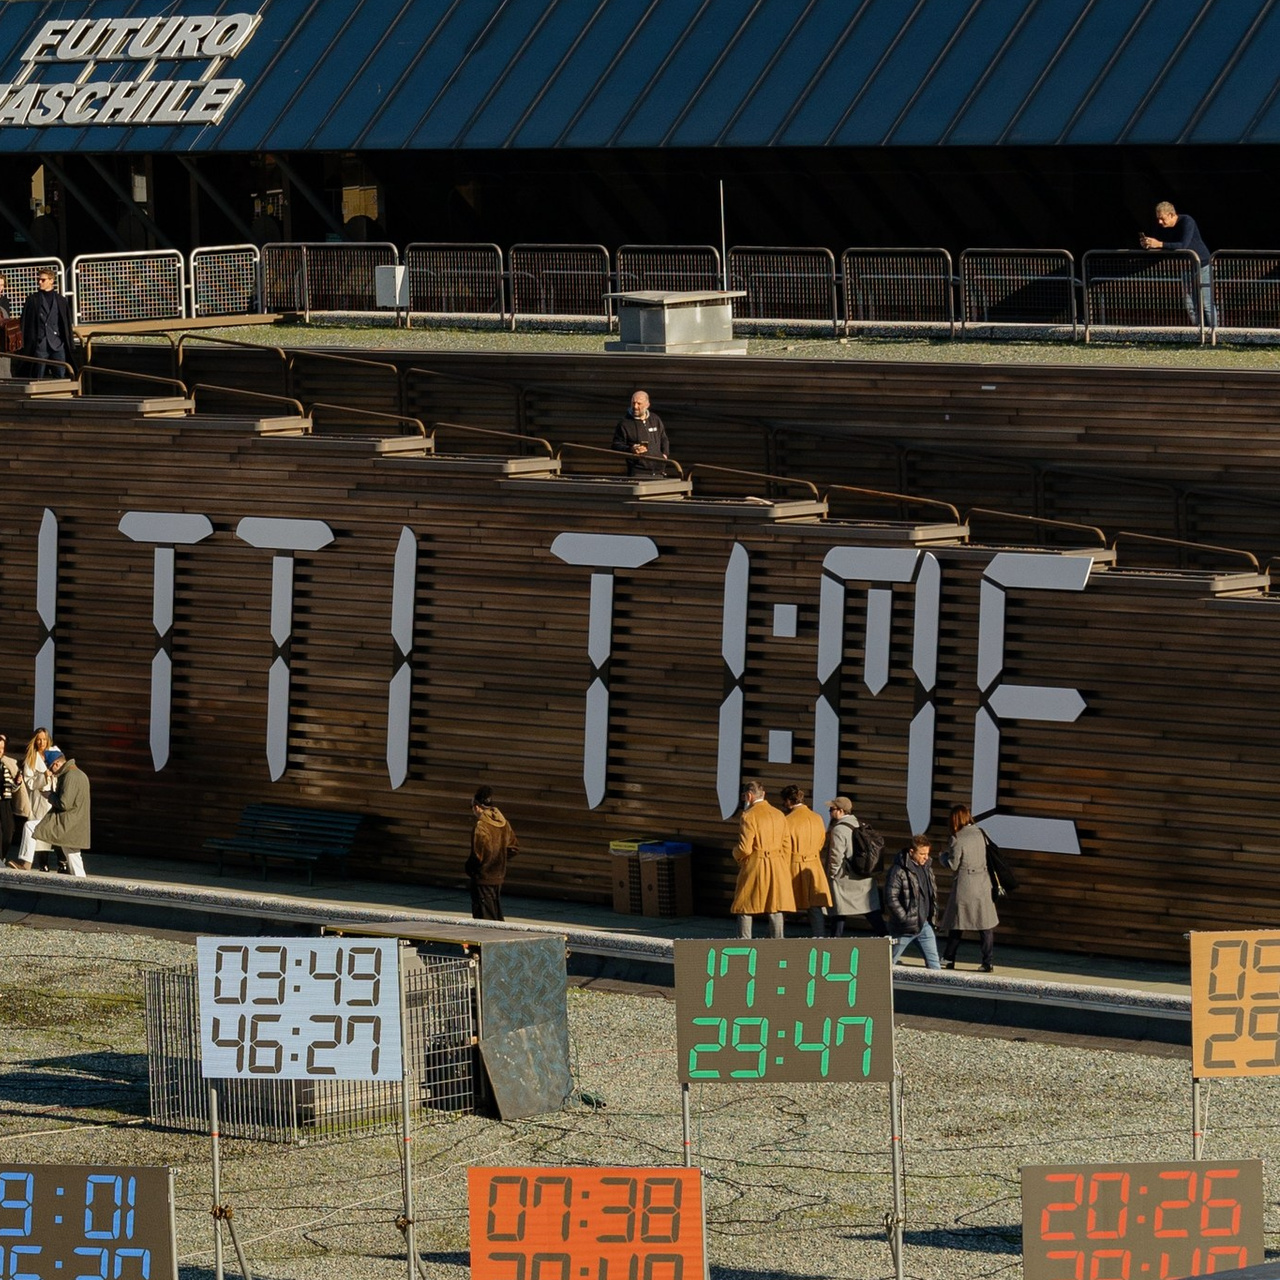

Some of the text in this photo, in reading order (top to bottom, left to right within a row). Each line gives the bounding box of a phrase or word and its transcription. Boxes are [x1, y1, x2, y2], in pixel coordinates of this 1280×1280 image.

[20, 13, 263, 62] FUTURO
[214, 945, 382, 1007] 03:49
[703, 946, 860, 1009] 17:14
[211, 1013, 382, 1076] 46:27
[687, 1016, 874, 1079] 29:47
[486, 1175, 683, 1243] 07:38
[1040, 1168, 1242, 1241] 20:26
